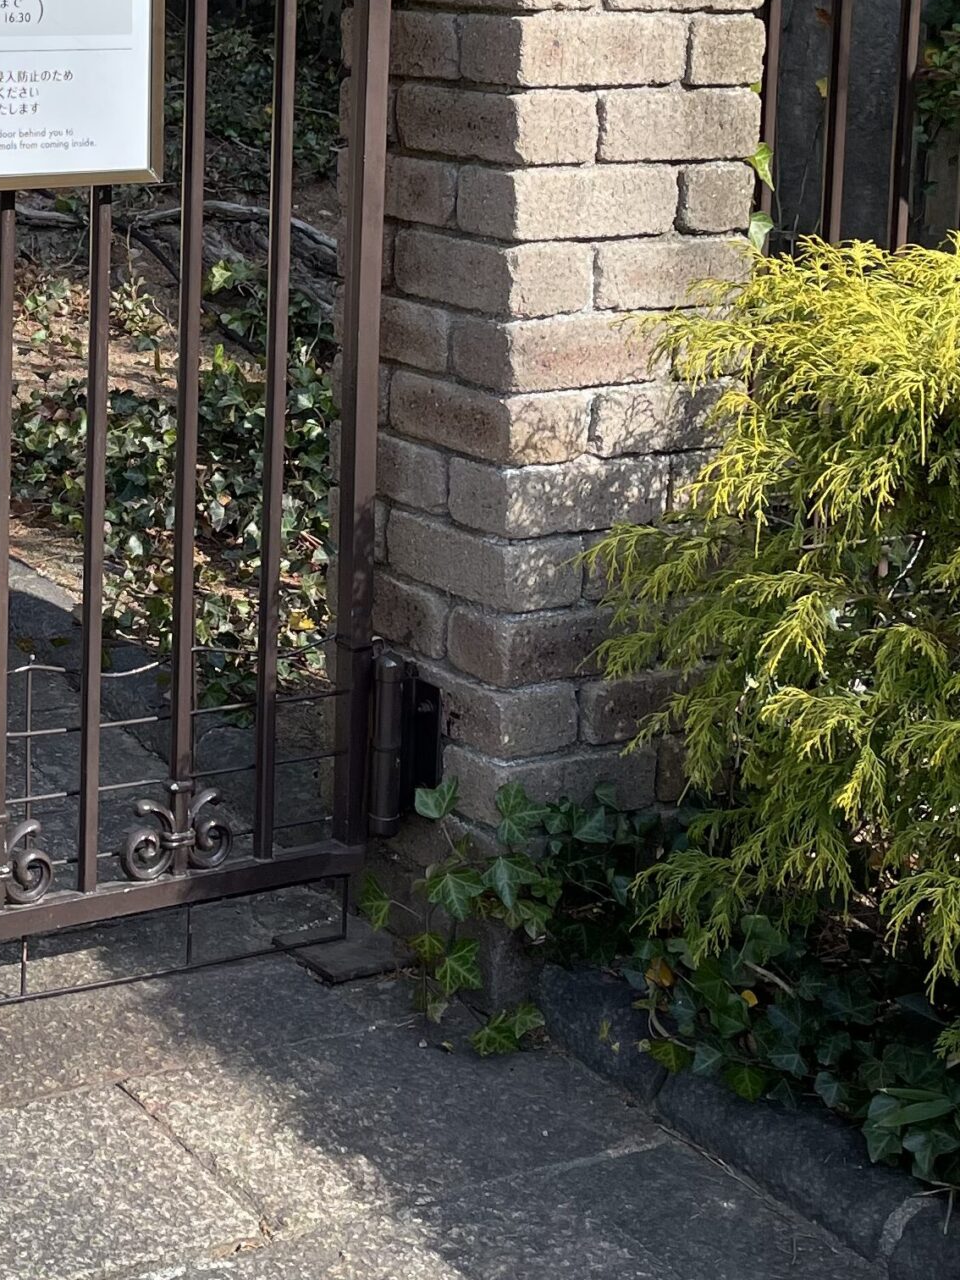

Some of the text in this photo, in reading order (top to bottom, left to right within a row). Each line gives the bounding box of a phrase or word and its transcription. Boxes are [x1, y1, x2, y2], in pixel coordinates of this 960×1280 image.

[19, 128, 46, 138] behind
[48, 129, 64, 139] you
[65, 128, 74, 136] to
[19, 140, 38, 150] from
[39, 140, 70, 151] coming
